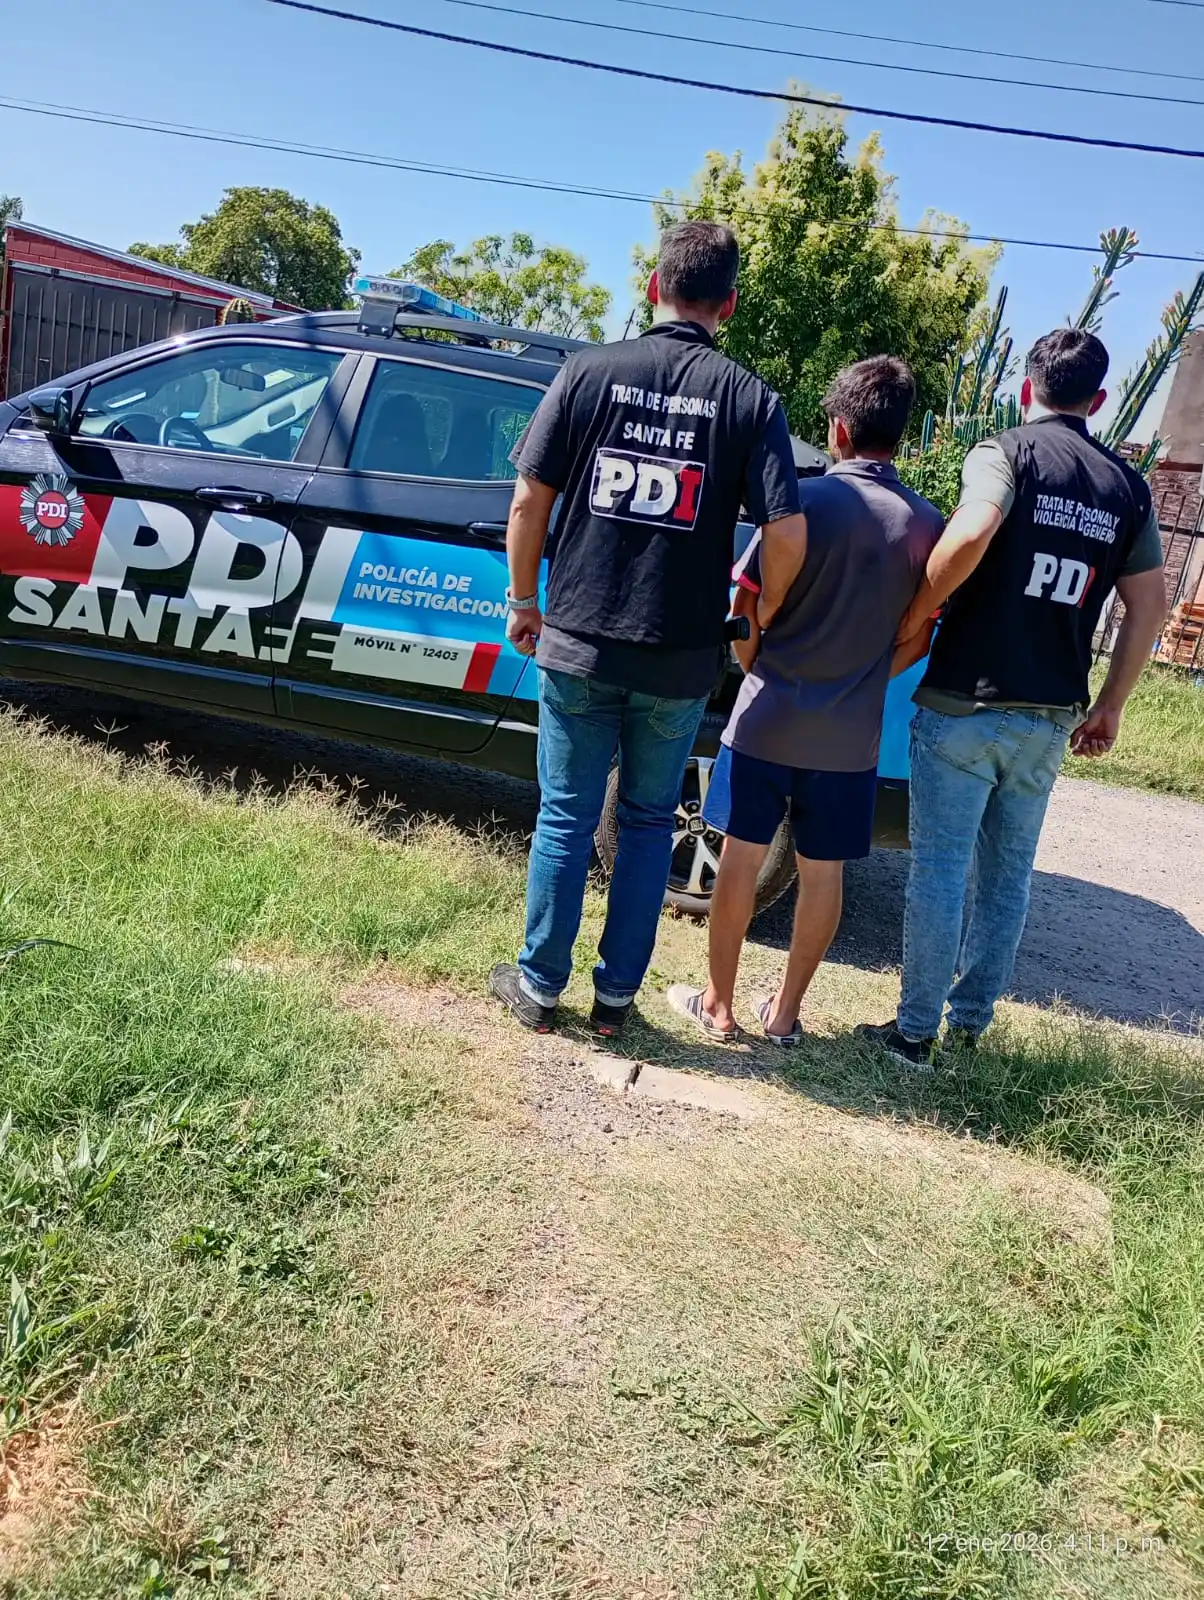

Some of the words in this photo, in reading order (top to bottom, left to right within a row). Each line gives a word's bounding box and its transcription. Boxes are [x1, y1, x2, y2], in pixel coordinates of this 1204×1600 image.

[611, 384, 644, 407] TRATA
[646, 391, 661, 411] DE
[662, 395, 717, 419] PERSONAS
[623, 421, 671, 448] SANTA
[675, 430, 695, 450] FE
[592, 456, 703, 522] PDI
[37, 502, 68, 518] PDI
[1036, 494, 1064, 512] TRATA
[1112, 515, 1120, 530] Y
[87, 496, 362, 621] PDI
[359, 562, 438, 588] POLICÍA
[442, 574, 472, 593] DE
[8, 575, 256, 659] SANTA
[250, 608, 343, 670] FE
[353, 636, 396, 652] MÓVIL
[422, 647, 459, 662] 12403
